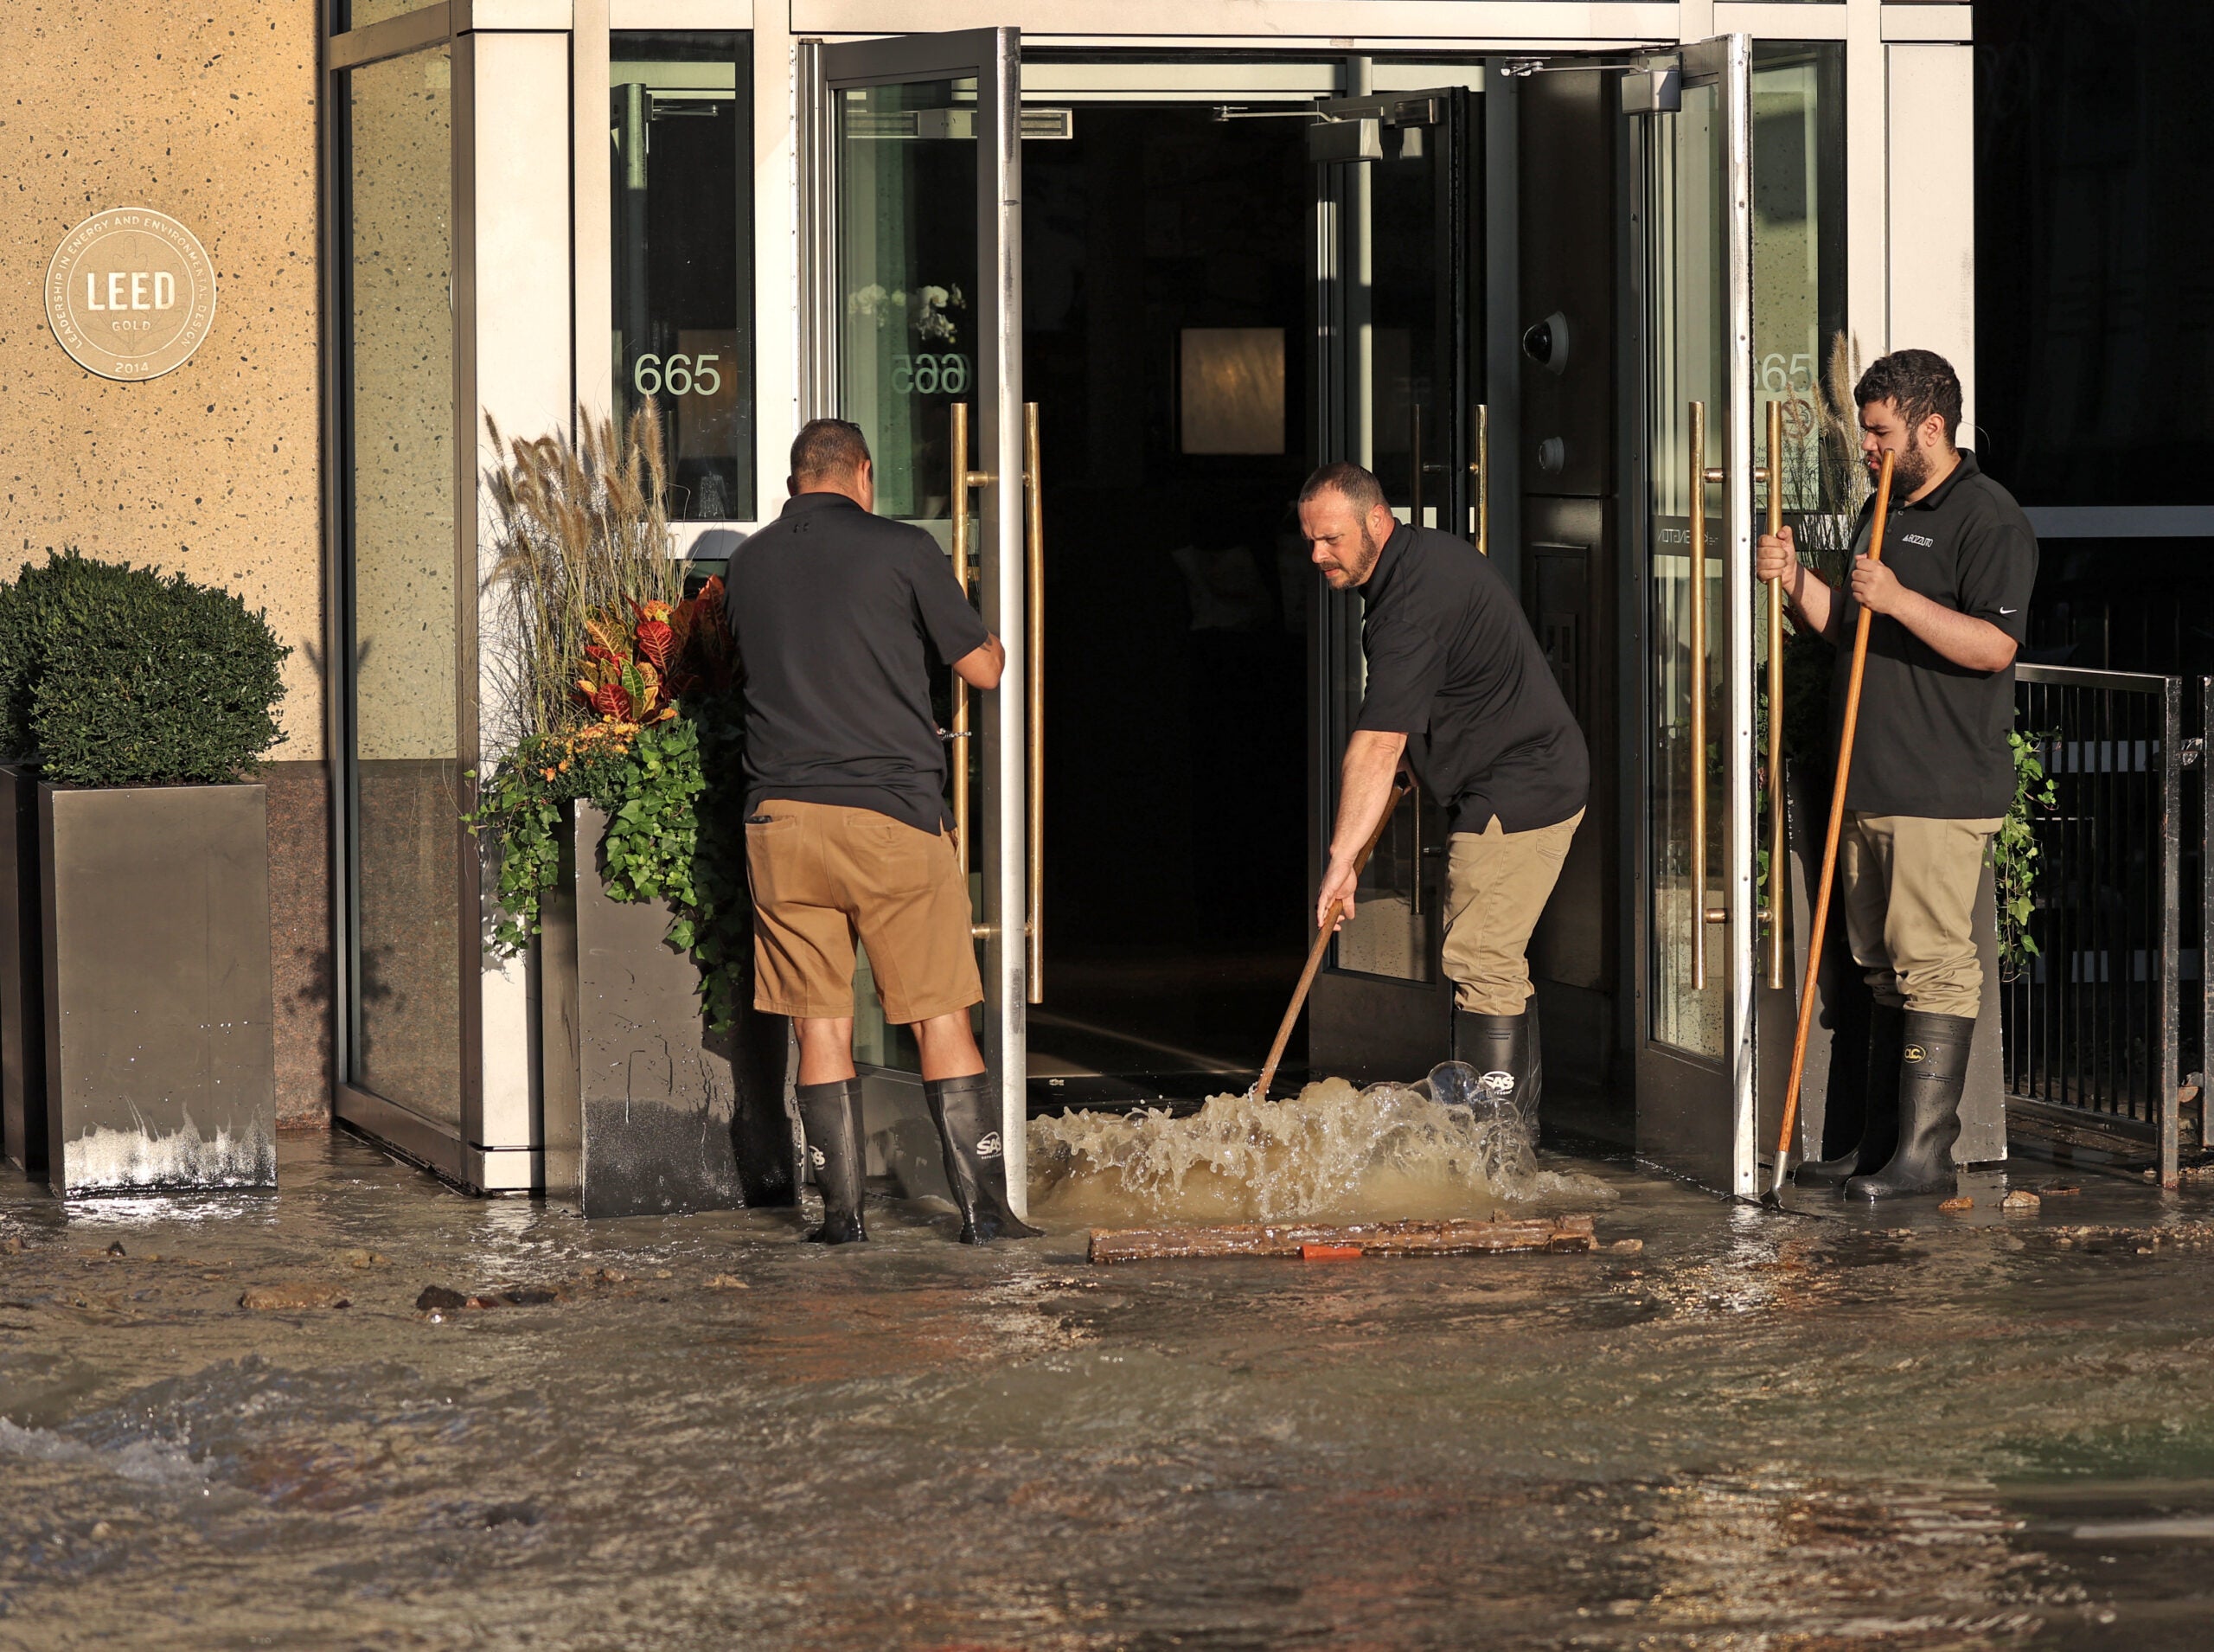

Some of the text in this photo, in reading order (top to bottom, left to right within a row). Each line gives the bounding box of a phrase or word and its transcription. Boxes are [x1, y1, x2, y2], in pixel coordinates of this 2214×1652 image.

[54, 216, 208, 349] LEADERSHIP IN ENERGY AND ENVIRONMENTAL DESIGN
[87, 271, 175, 311] LEED
[112, 320, 151, 331] GOLD
[114, 362, 150, 374] 2014
[634, 353, 721, 396] 665
[1755, 353, 1812, 393] 65
[1481, 1076, 1515, 1091] SAS
